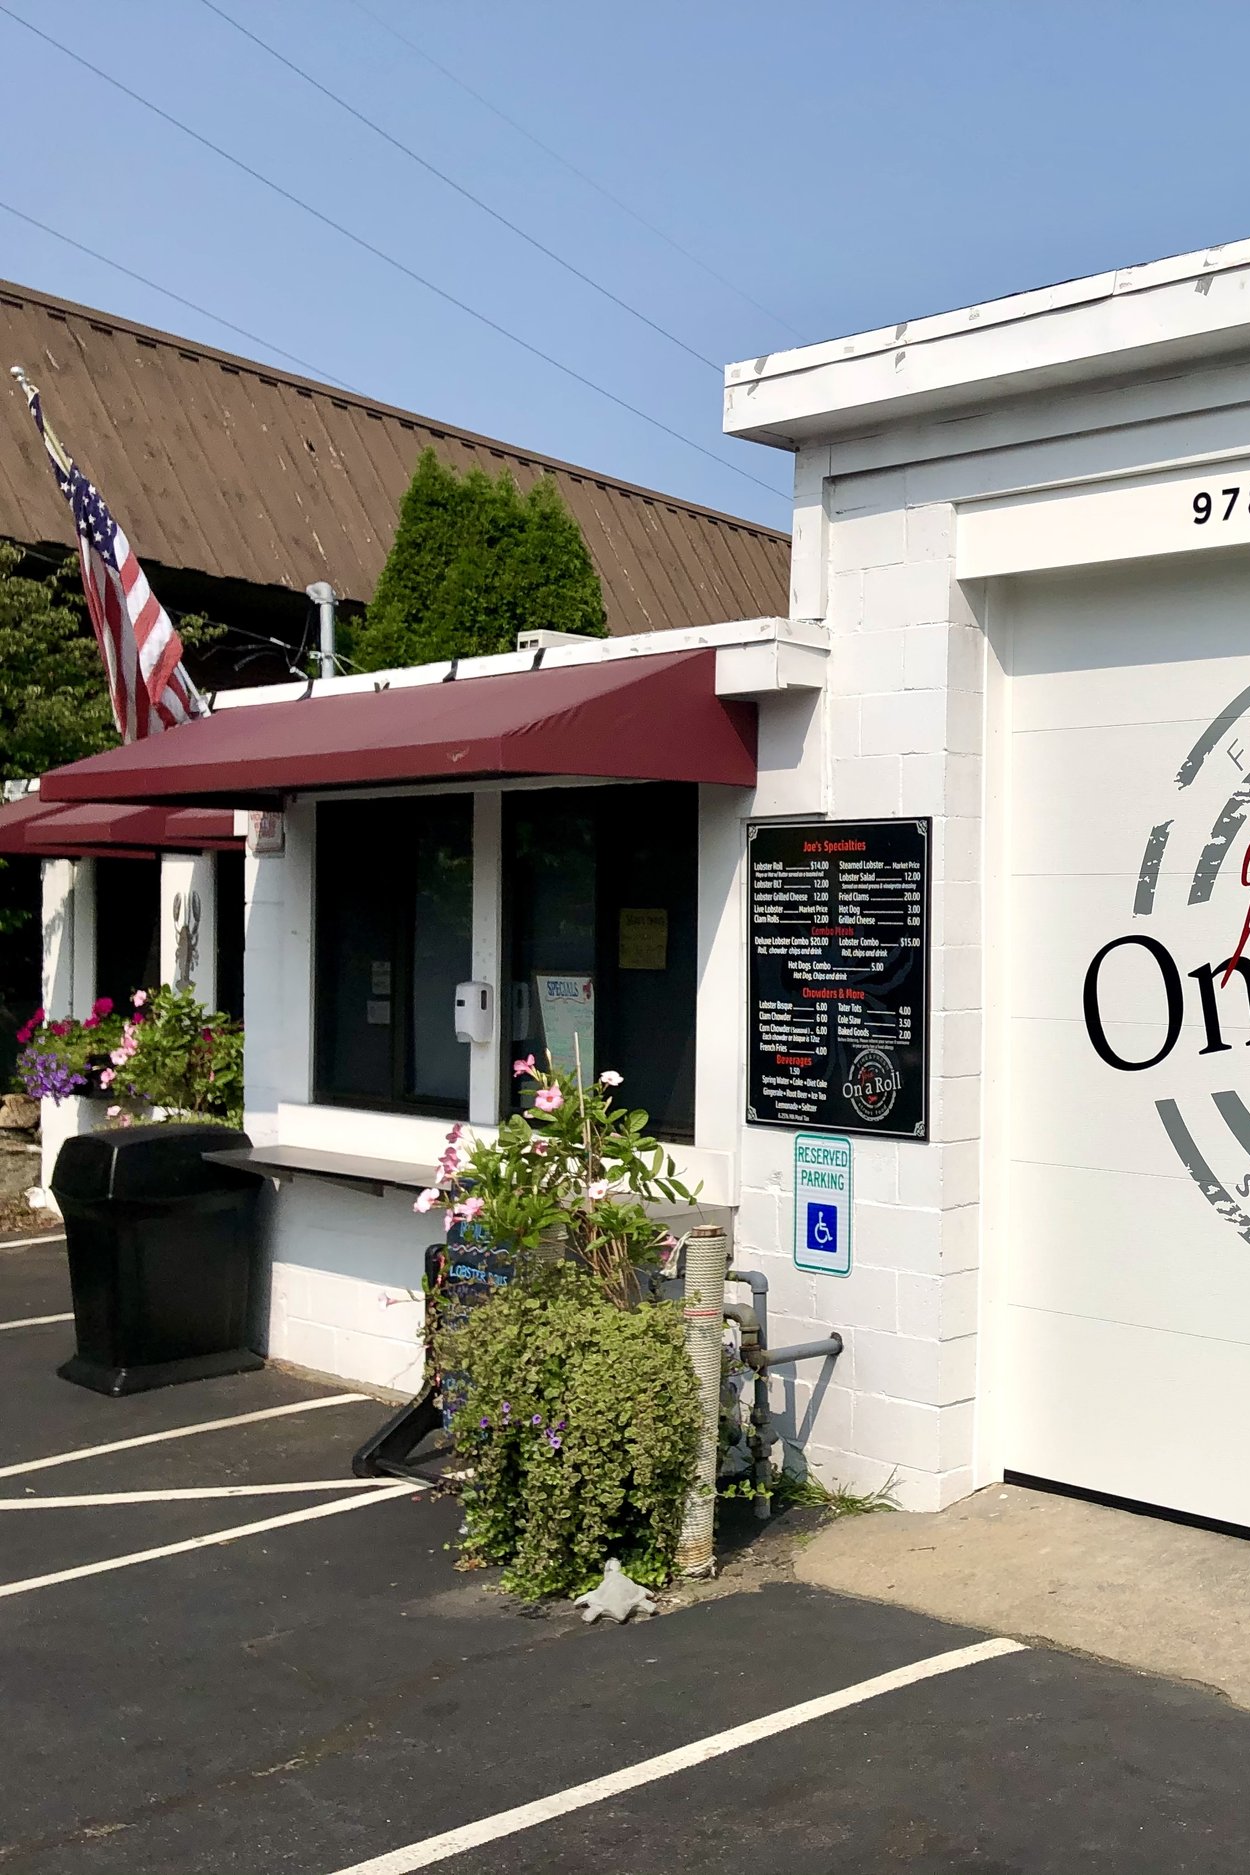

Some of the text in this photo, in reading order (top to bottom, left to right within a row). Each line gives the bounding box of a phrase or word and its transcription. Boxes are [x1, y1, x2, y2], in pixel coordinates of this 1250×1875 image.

[803, 840, 866, 853] Joe's Specialties
[753, 861, 829, 871] Lobster Roll $14.00
[839, 860, 863, 869] Steamed
[863, 860, 884, 869] Lobster
[908, 861, 920, 869] Price
[839, 872, 921, 881] Lobster Salad 12.00
[754, 880, 829, 888] Lobster BLT 12.00
[754, 892, 829, 901] Lobster Grilled Cheese 12.00
[839, 892, 920, 901] Fried Clams 20.00
[754, 905, 764, 913] Live
[765, 905, 783, 913] Lobster
[816, 905, 828, 913] Price
[839, 905, 920, 915] Hot Dog 3.00
[754, 915, 829, 923] Clam Rolls 12.00
[839, 915, 920, 925] Grilled Cheese 6.00
[811, 926, 854, 936] Combo Meals
[754, 937, 829, 945] Deluxe Lobster Combo $20.00
[839, 937, 920, 947] Lobster Combo $15.00
[788, 961, 884, 971] Hot Dogs Combo 5.00
[803, 988, 865, 999] Chowders & More
[759, 1001, 776, 1009] Lobster
[777, 1001, 793, 1011] Bisque
[838, 1003, 911, 1015] Tater Tots 4.00
[759, 1012, 771, 1020] Clam
[772, 1012, 791, 1021] Chowder
[838, 1015, 911, 1027] Cole Slaw 3.50
[759, 1024, 770, 1032] Corn
[771, 1024, 790, 1033] Chowder
[838, 1027, 911, 1039] Baked Goods 2.00
[760, 1042, 775, 1051] French
[776, 1043, 788, 1052] Fries
[776, 1054, 812, 1067] Beverages
[842, 1082, 863, 1098] On
[865, 1082, 873, 1094] a
[874, 1071, 902, 1093] Roll
[797, 1146, 848, 1167] RESERVED
[801, 1169, 845, 1190] PARKING
